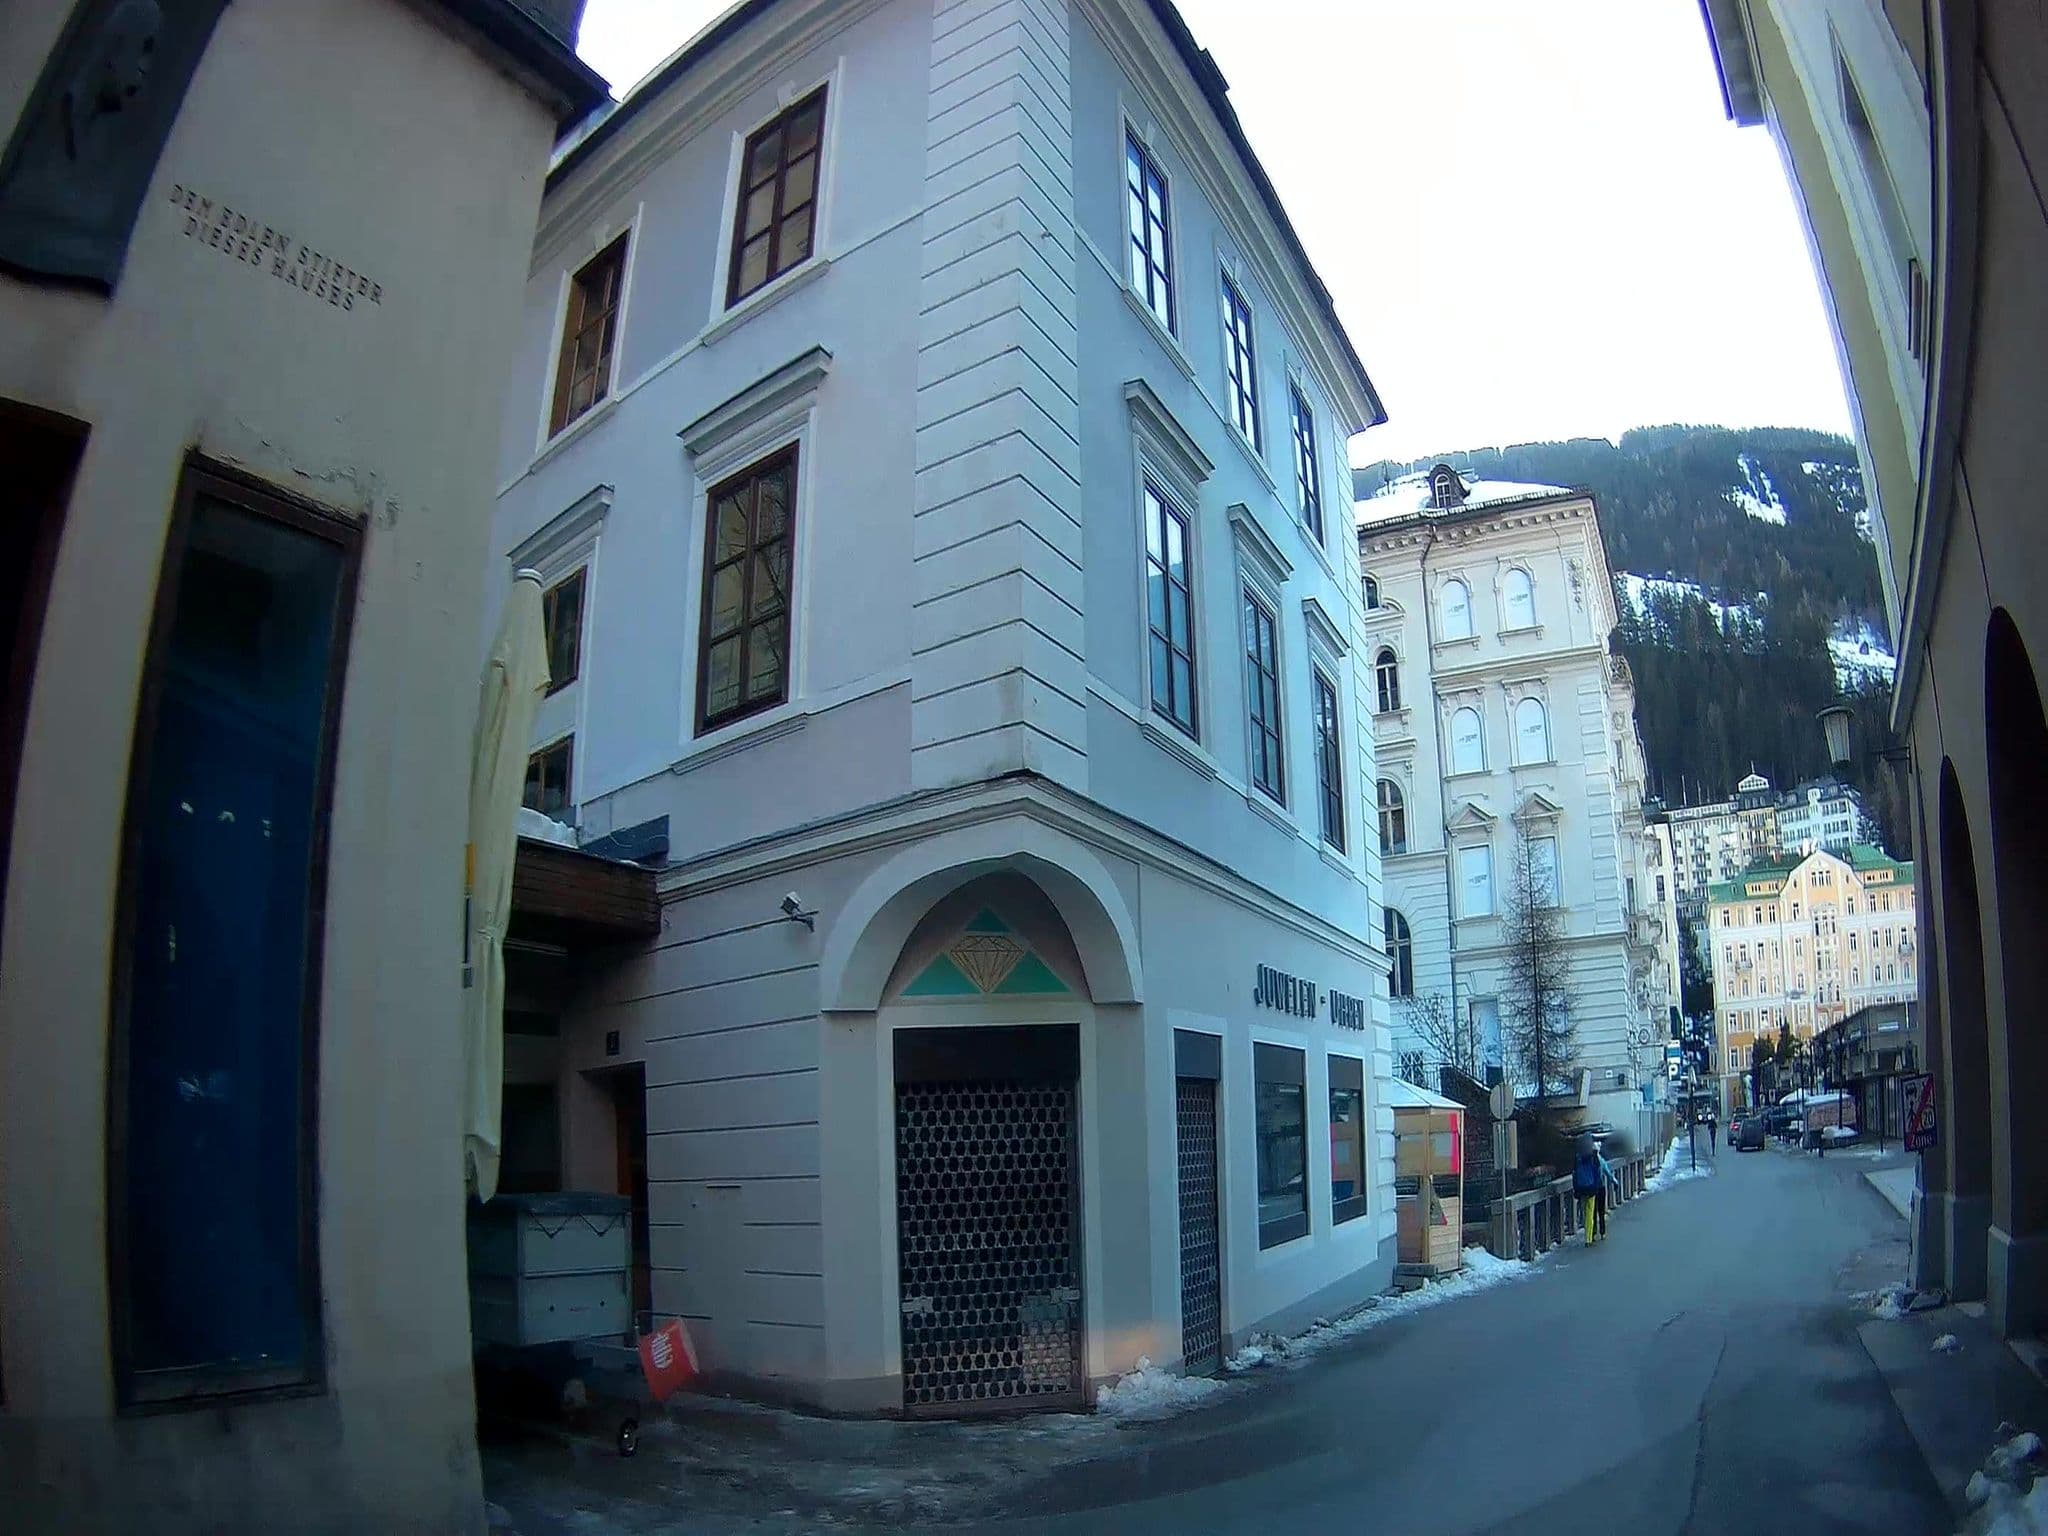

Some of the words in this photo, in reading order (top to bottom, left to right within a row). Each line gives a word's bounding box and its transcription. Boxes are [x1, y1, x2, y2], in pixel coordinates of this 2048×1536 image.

[169, 184, 212, 218] DEM
[221, 206, 290, 253] EDLEN
[298, 246, 383, 306] STIFTER
[184, 215, 262, 266] DIESES
[271, 256, 354, 312] HAUSES
[1253, 963, 1317, 1019] JUWELEN
[1329, 988, 1365, 1031] UHREN
